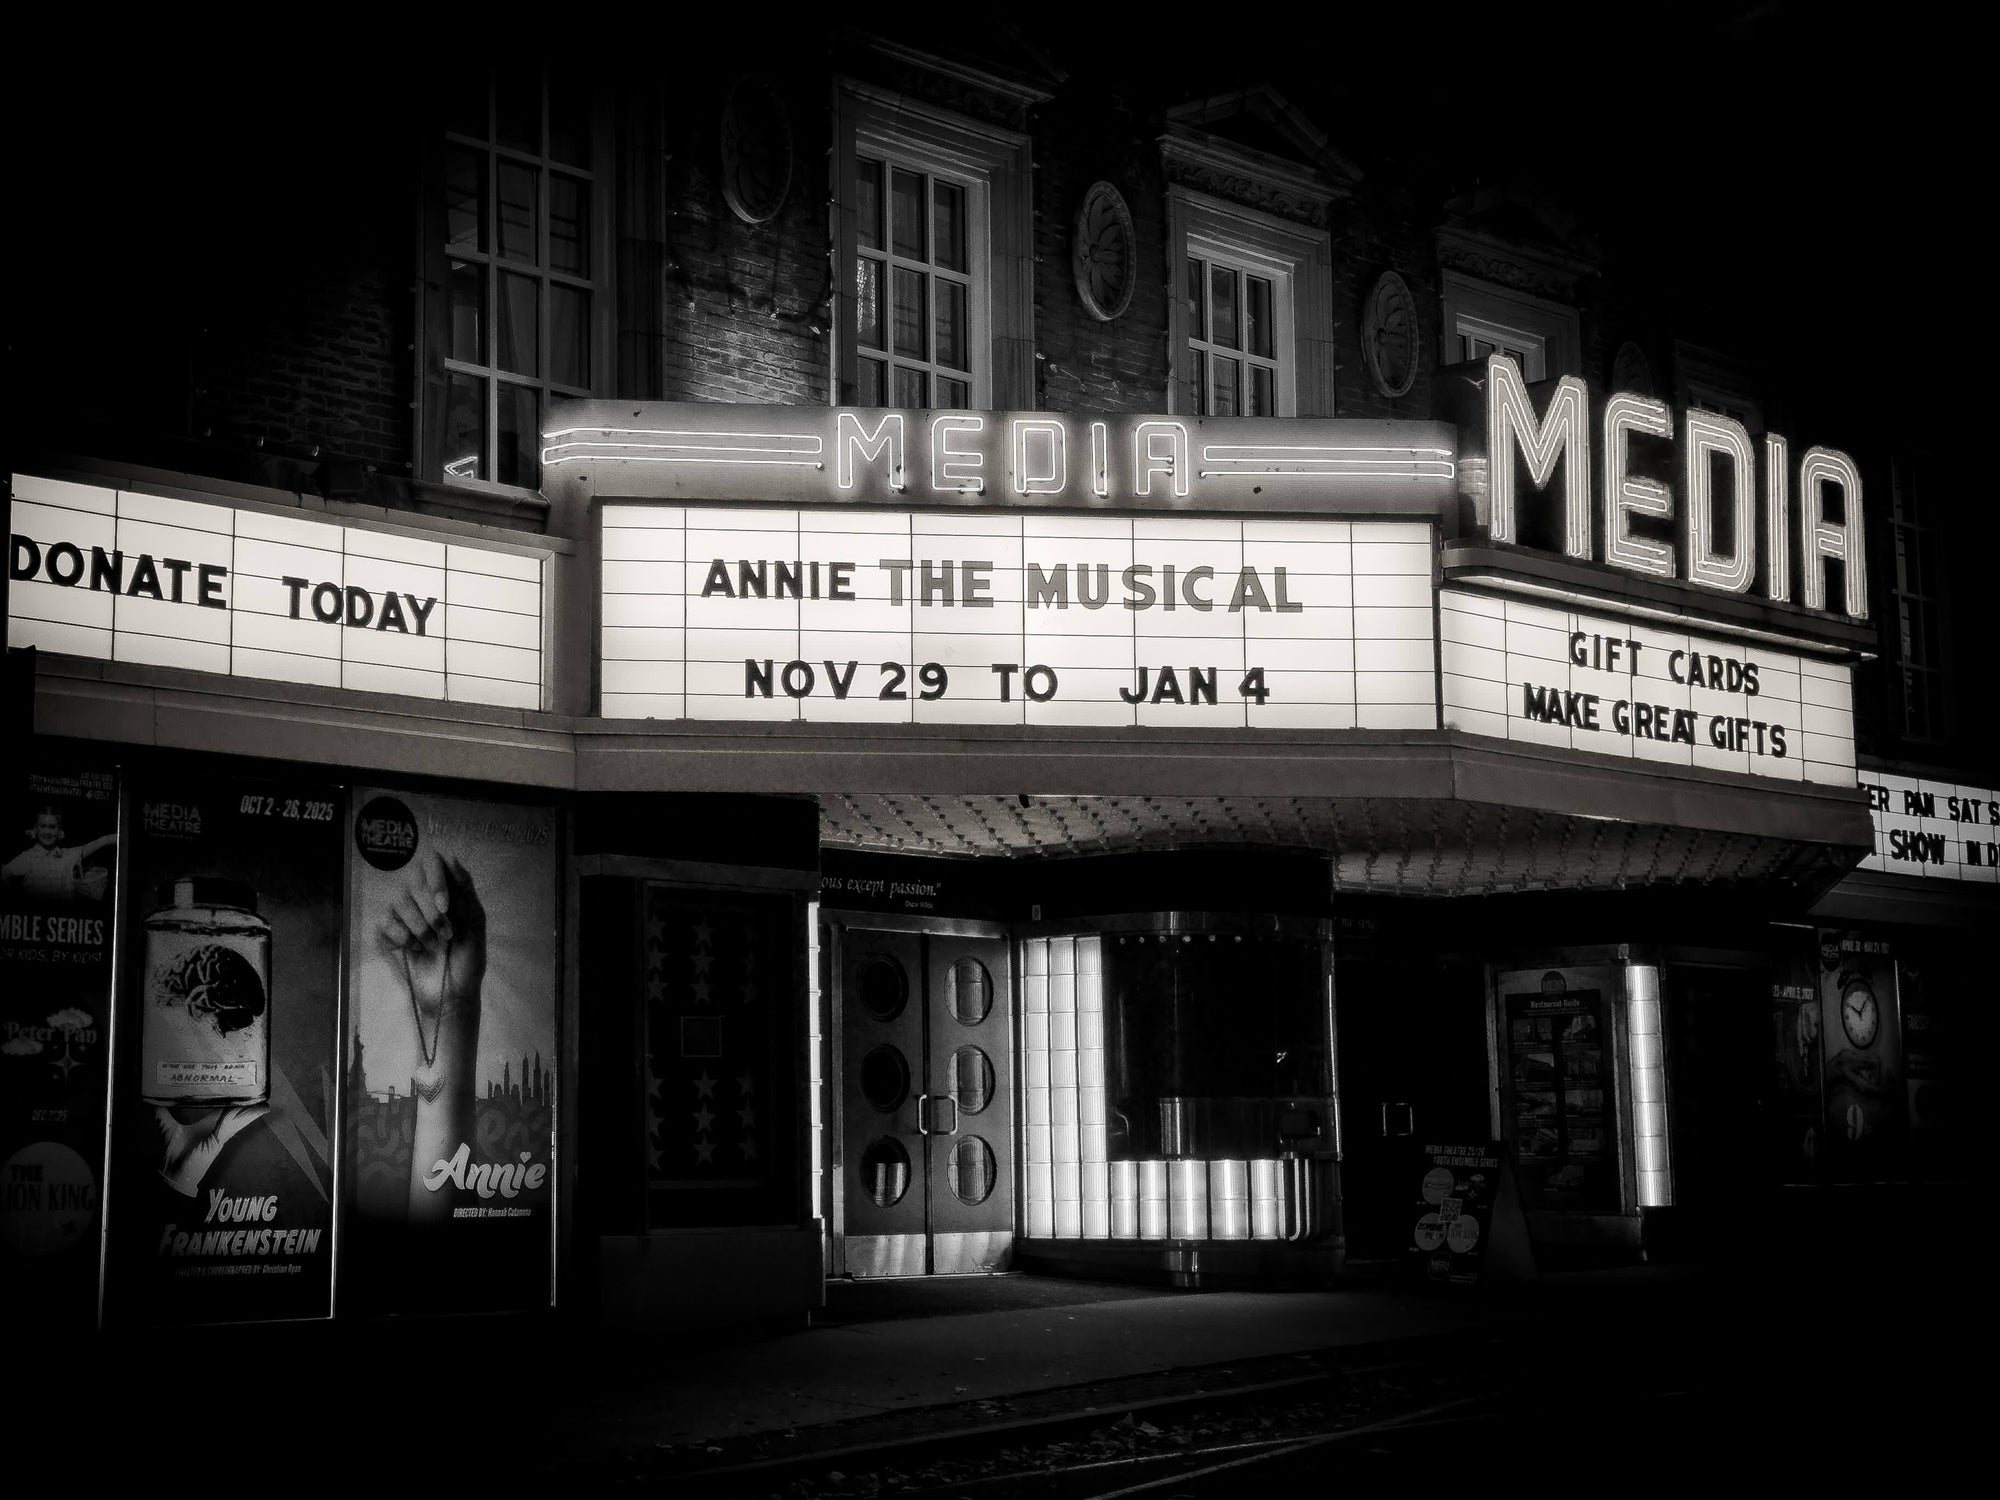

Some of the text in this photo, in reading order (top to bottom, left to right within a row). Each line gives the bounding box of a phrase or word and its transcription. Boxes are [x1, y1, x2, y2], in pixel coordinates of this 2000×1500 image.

[835, 412, 1191, 498] MEDIA
[1488, 353, 1869, 620] MEDIA
[9, 534, 438, 637] DONATE TODAY
[701, 558, 1304, 614] ANNIE THE MUSICAL
[1569, 632, 1761, 697] GIFT CARDS
[743, 659, 1272, 706] NOV 29 TO JAN 4
[1523, 682, 1787, 759] MAKE GREAT GIFTS
[143, 801, 202, 822] MEDIA
[240, 795, 263, 814] OCT
[264, 797, 274, 816] 2
[283, 799, 300, 820] 26,
[303, 801, 334, 821] 2025
[1857, 783, 1889, 812] ER
[1904, 789, 1935, 818] PAN
[1948, 796, 1981, 824] SAT
[143, 817, 202, 834] THEATRE
[360, 817, 415, 838] MEDIA
[361, 832, 415, 849] THEATRE
[1889, 829, 1945, 865] SHOW
[847, 879, 885, 898] except
[46, 916, 104, 945] SERIES
[52, 950, 69, 962] BY
[2, 1020, 55, 1041] Peter
[422, 1142, 546, 1199] Annie
[48, 1183, 93, 1211] KING
